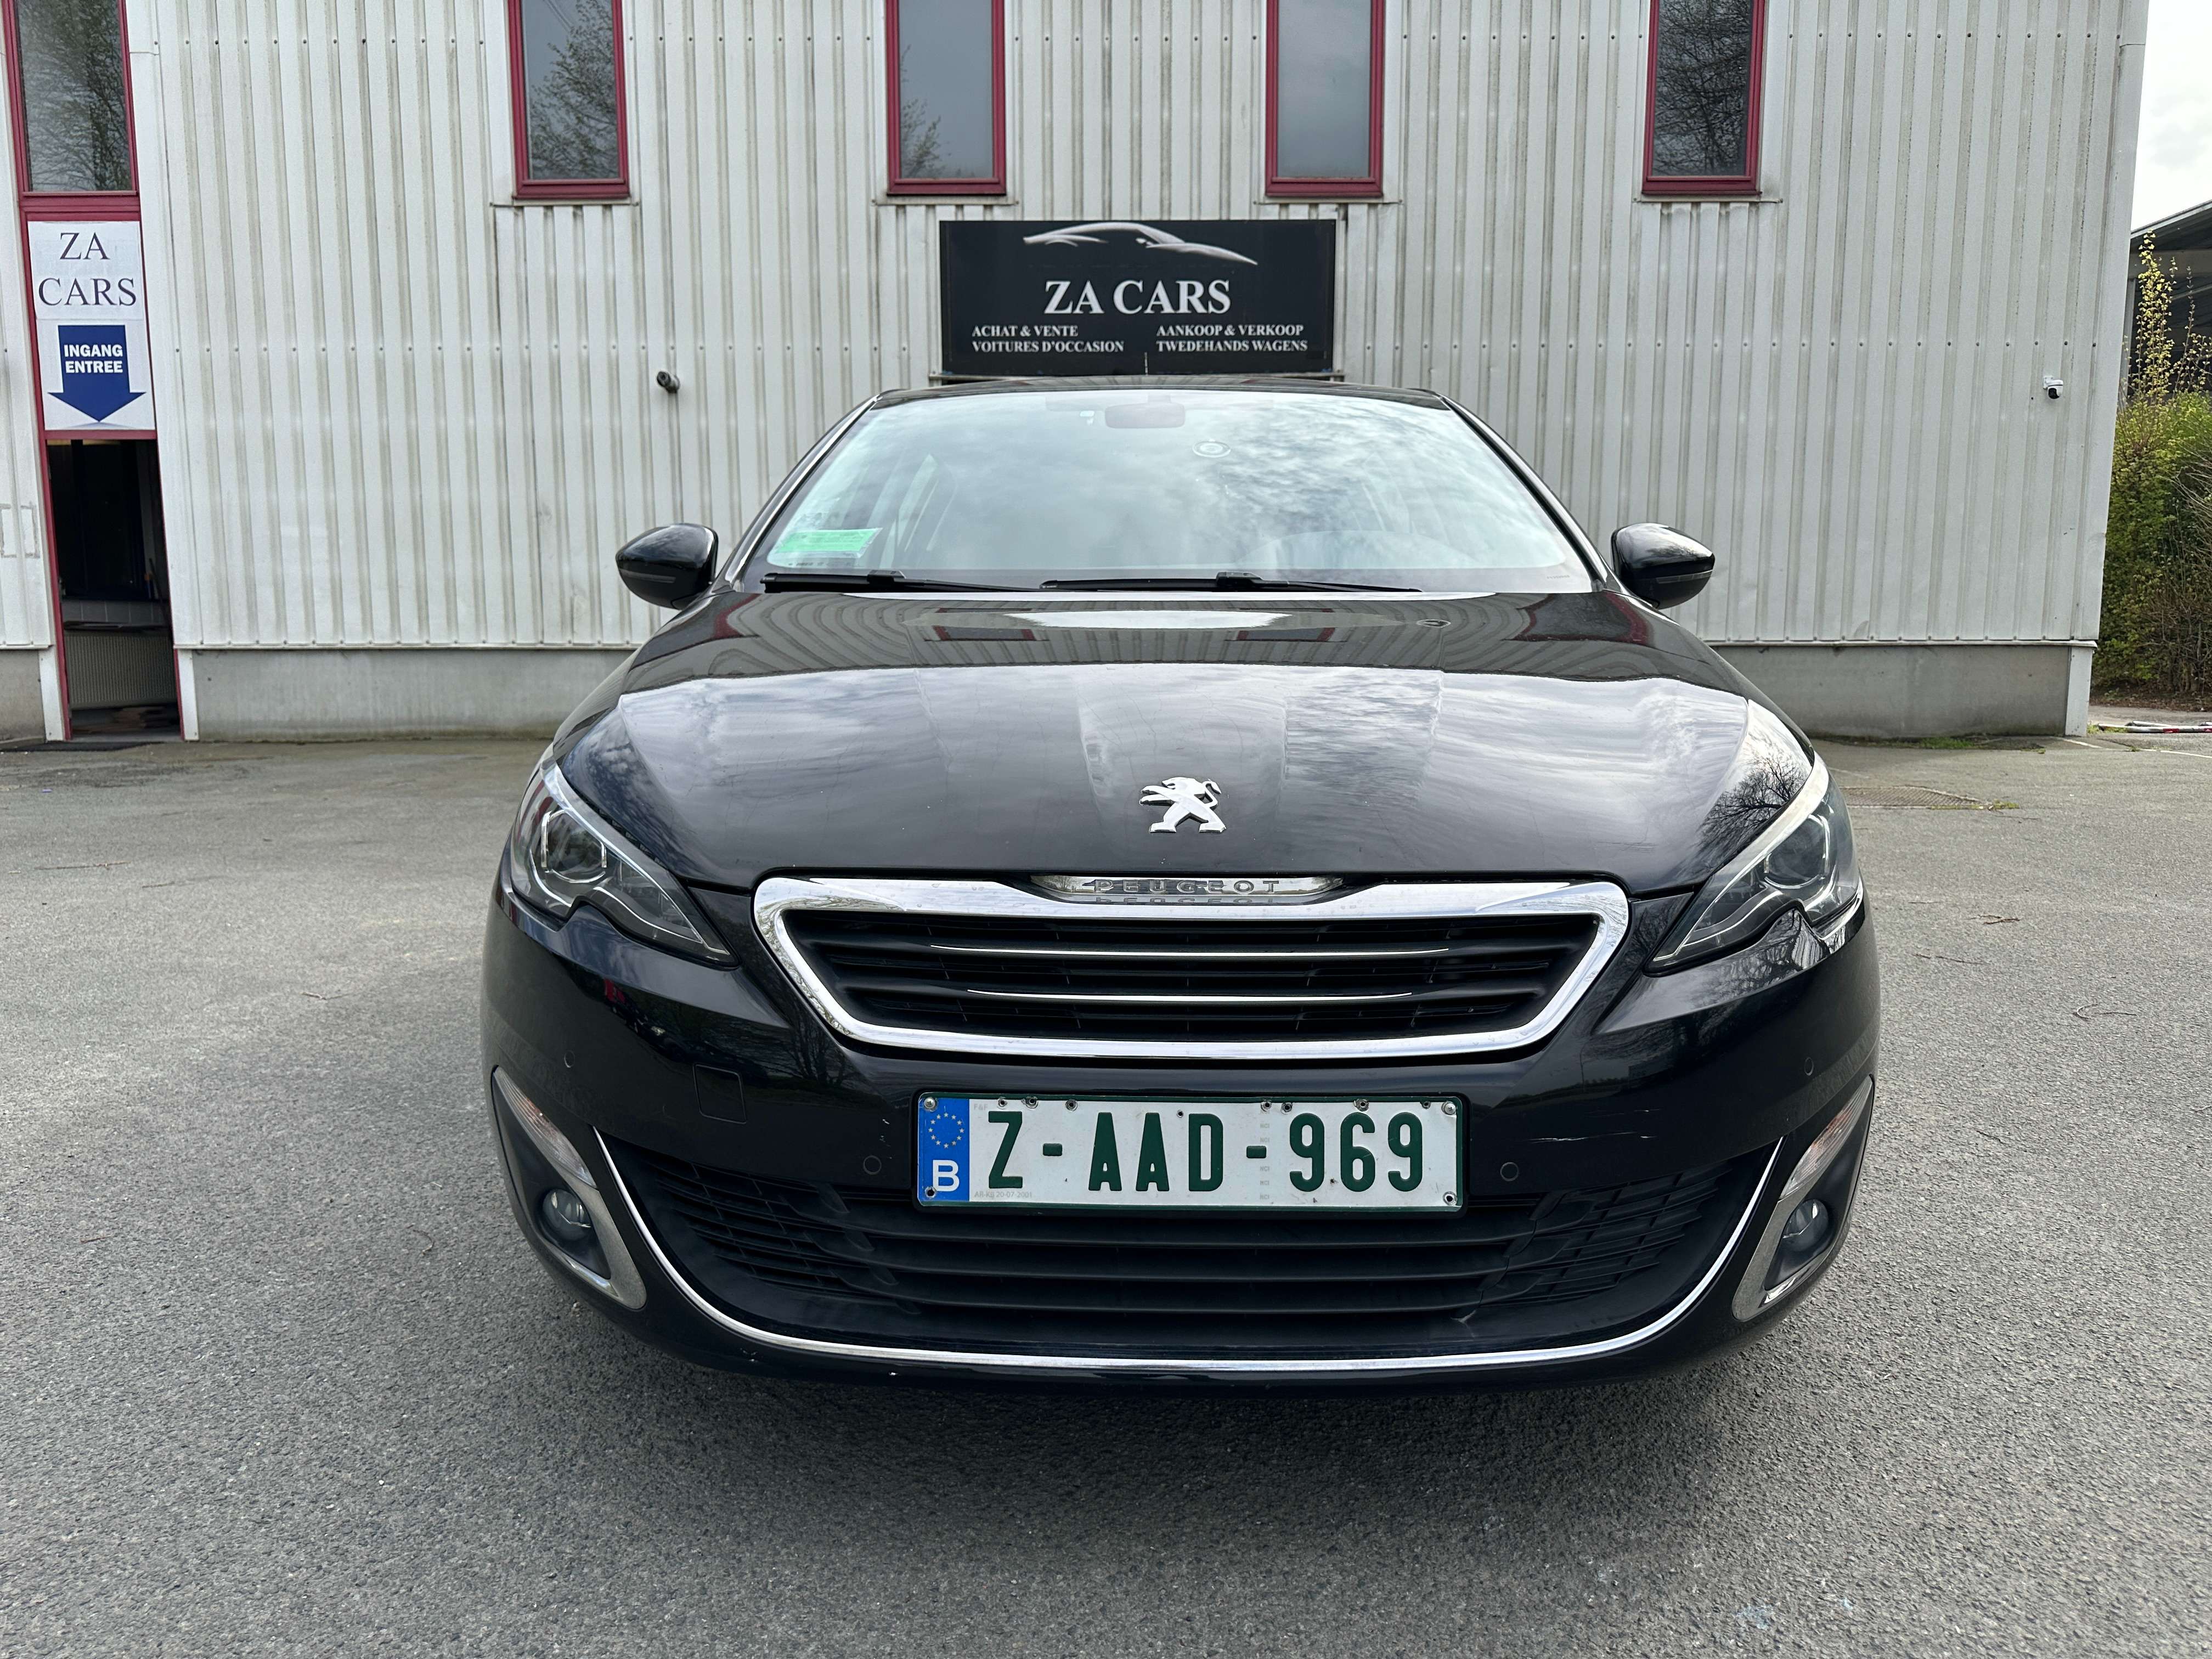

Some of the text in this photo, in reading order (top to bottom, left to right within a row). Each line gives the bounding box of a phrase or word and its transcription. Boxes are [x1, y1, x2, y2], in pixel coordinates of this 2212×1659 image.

[60, 232, 110, 260] ZA
[38, 278, 137, 306] CARS
[1044, 280, 1230, 314] ZA CARS
[972, 325, 1079, 337] ACHAT & VENTE
[1156, 324, 1304, 336] AANKOOP & VERKOOP
[64, 344, 123, 357] INGANG
[972, 341, 1124, 352] VOITURES D'OCCASION
[1156, 340, 1308, 352] TWEDEHANDS WAGENS
[65, 361, 123, 373] ENTREE
[1095, 879, 1280, 893] PEUGEOT
[989, 1110, 1423, 1192] Z-AAD-969
[933, 1160, 960, 1192] B
